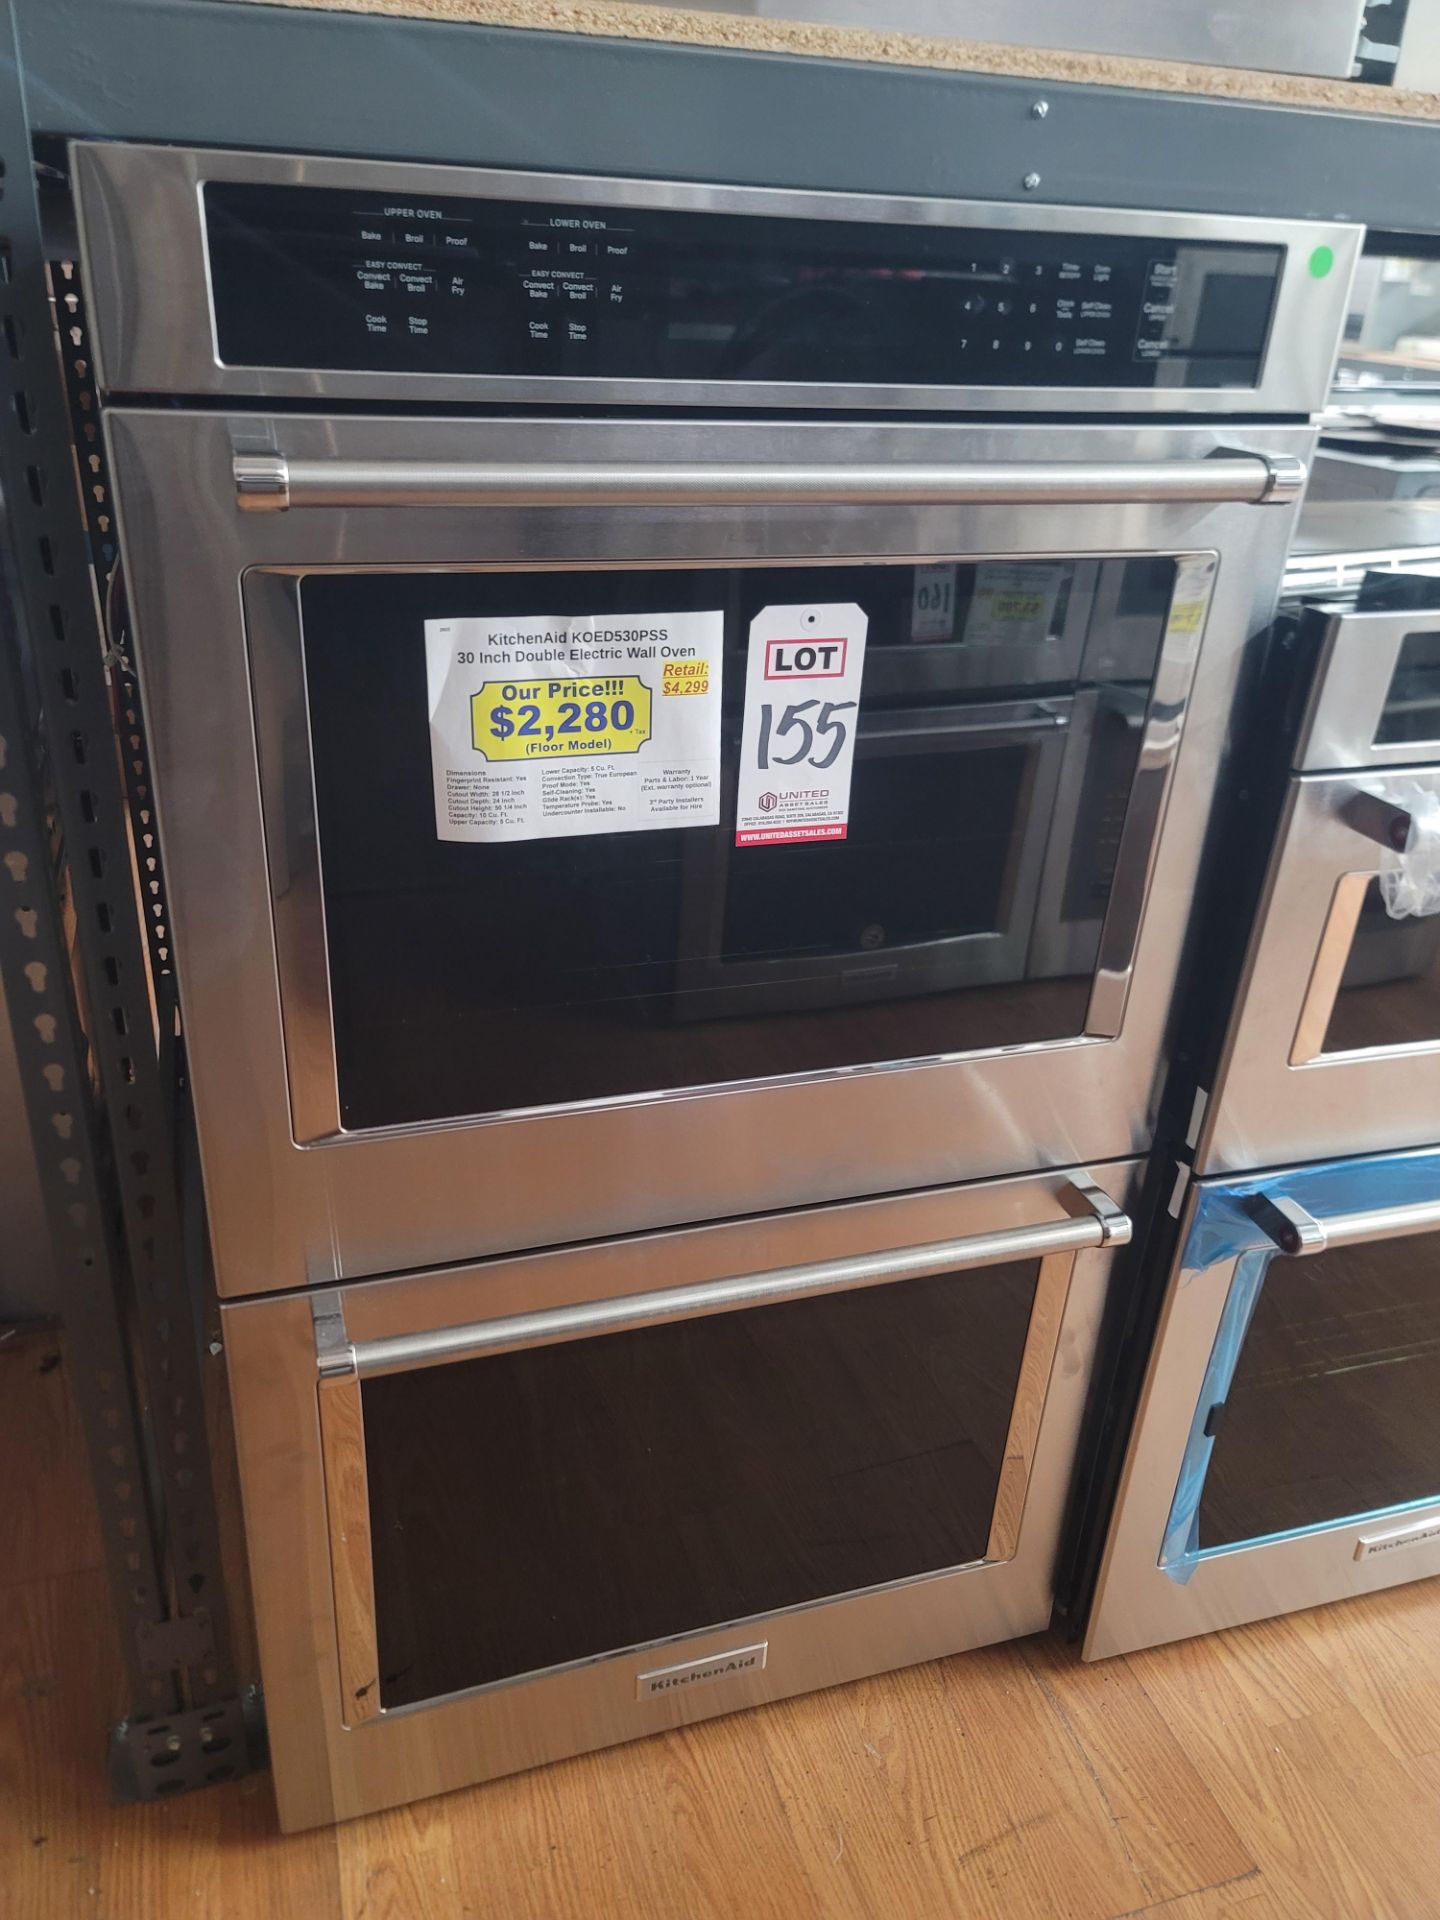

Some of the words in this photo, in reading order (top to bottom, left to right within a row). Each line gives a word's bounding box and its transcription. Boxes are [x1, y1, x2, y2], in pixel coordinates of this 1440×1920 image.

[384, 207, 414, 218] UPPER
[416, 209, 442, 219] OVEN
[550, 218, 580, 228] LOWER
[582, 220, 606, 230] OVEN
[361, 230, 382, 240] Bake
[405, 234, 424, 244] Broil
[446, 236, 468, 246] Proof
[528, 241, 548, 251] Bake
[569, 243, 587, 253] Broil
[608, 246, 628, 255] Proof
[366, 260, 385, 269] EASY
[386, 262, 422, 271] CONVECT
[972, 262, 976, 272] 1
[1002, 264, 1010, 274] 2
[1035, 265, 1042, 276] 3
[356, 270, 391, 281] Convect
[400, 273, 432, 284] Convect
[531, 270, 550, 278] EASY
[550, 272, 584, 280] CONVECT
[364, 280, 384, 290] Bake
[452, 276, 464, 286] Air
[522, 280, 554, 290] Convect
[407, 283, 426, 292] Broil
[452, 286, 465, 296] Fry
[562, 282, 594, 292] Convect
[612, 284, 622, 293] Air
[529, 290, 548, 298] Bake
[569, 291, 588, 300] Broil
[610, 292, 624, 303] Fry
[964, 301, 971, 310] 4
[998, 302, 1004, 312] 5
[1029, 303, 1037, 314] 6
[1143, 302, 1174, 314] Cancel
[366, 314, 388, 324] Cook
[408, 316, 428, 326] Stop
[366, 323, 387, 333] Time
[409, 326, 429, 335] Time
[529, 322, 549, 331] Cook
[568, 323, 586, 332] Stop
[530, 330, 549, 339] Time
[568, 332, 587, 340] Time
[961, 338, 968, 348] 7
[992, 340, 1000, 350] 8
[1024, 340, 1032, 351] 9
[1056, 342, 1062, 352] 0
[1138, 338, 1168, 350] Cancel
[488, 632, 567, 646] KitchenAid
[572, 630, 668, 644] KOED530PSS
[458, 652, 474, 664] 30
[479, 650, 510, 664] Inch
[516, 648, 565, 662] Double
[570, 648, 622, 660] Electric
[627, 646, 656, 658] Wall
[660, 645, 696, 658] Oven
[775, 646, 838, 672] LOT
[663, 662, 709, 676] Retail:
[502, 685, 541, 700] Our
[548, 680, 625, 698] Price!!!
[490, 700, 635, 741] $2,280
[758, 699, 857, 770] 155
[526, 742, 563, 756] (Floor
[568, 738, 612, 750] Model)
[542, 788, 584, 796] Self-Cleaning:
[778, 790, 830, 800] UNITED
[542, 802, 580, 810] Temperature
[740, 828, 842, 842] WWW.UNITEDASSETSALES.COM
[651, 1656, 756, 1692] KitchenAid
